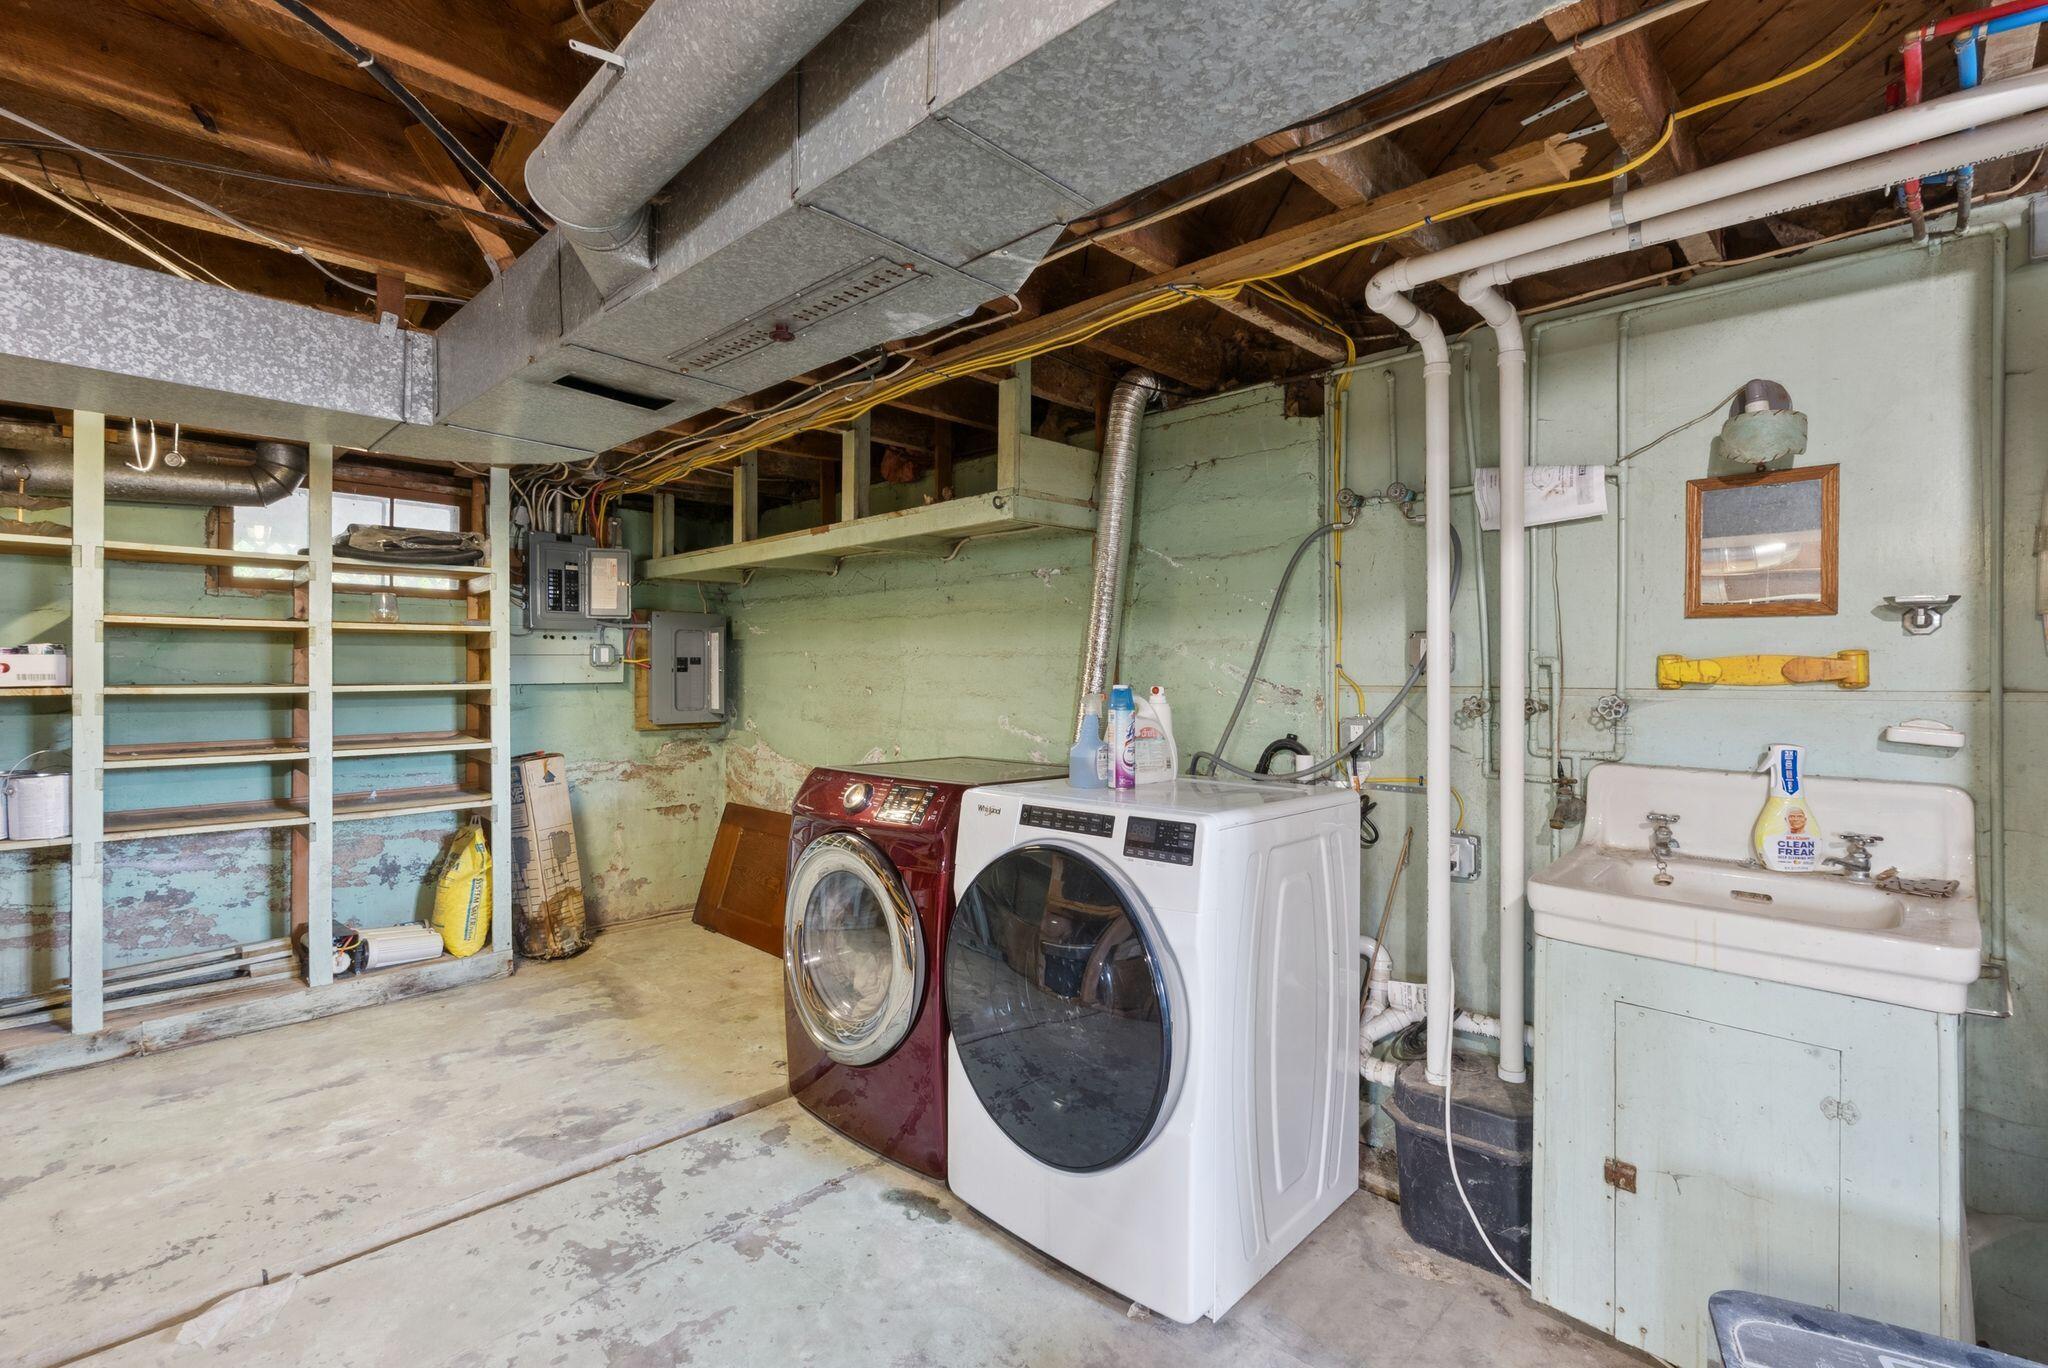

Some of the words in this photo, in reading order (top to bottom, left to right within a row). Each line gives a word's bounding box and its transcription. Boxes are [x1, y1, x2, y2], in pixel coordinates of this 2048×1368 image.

[977, 804, 1002, 816] Whirlpool
[1777, 840, 1815, 849] CLEAN
[1778, 848, 1815, 856] FREAK
